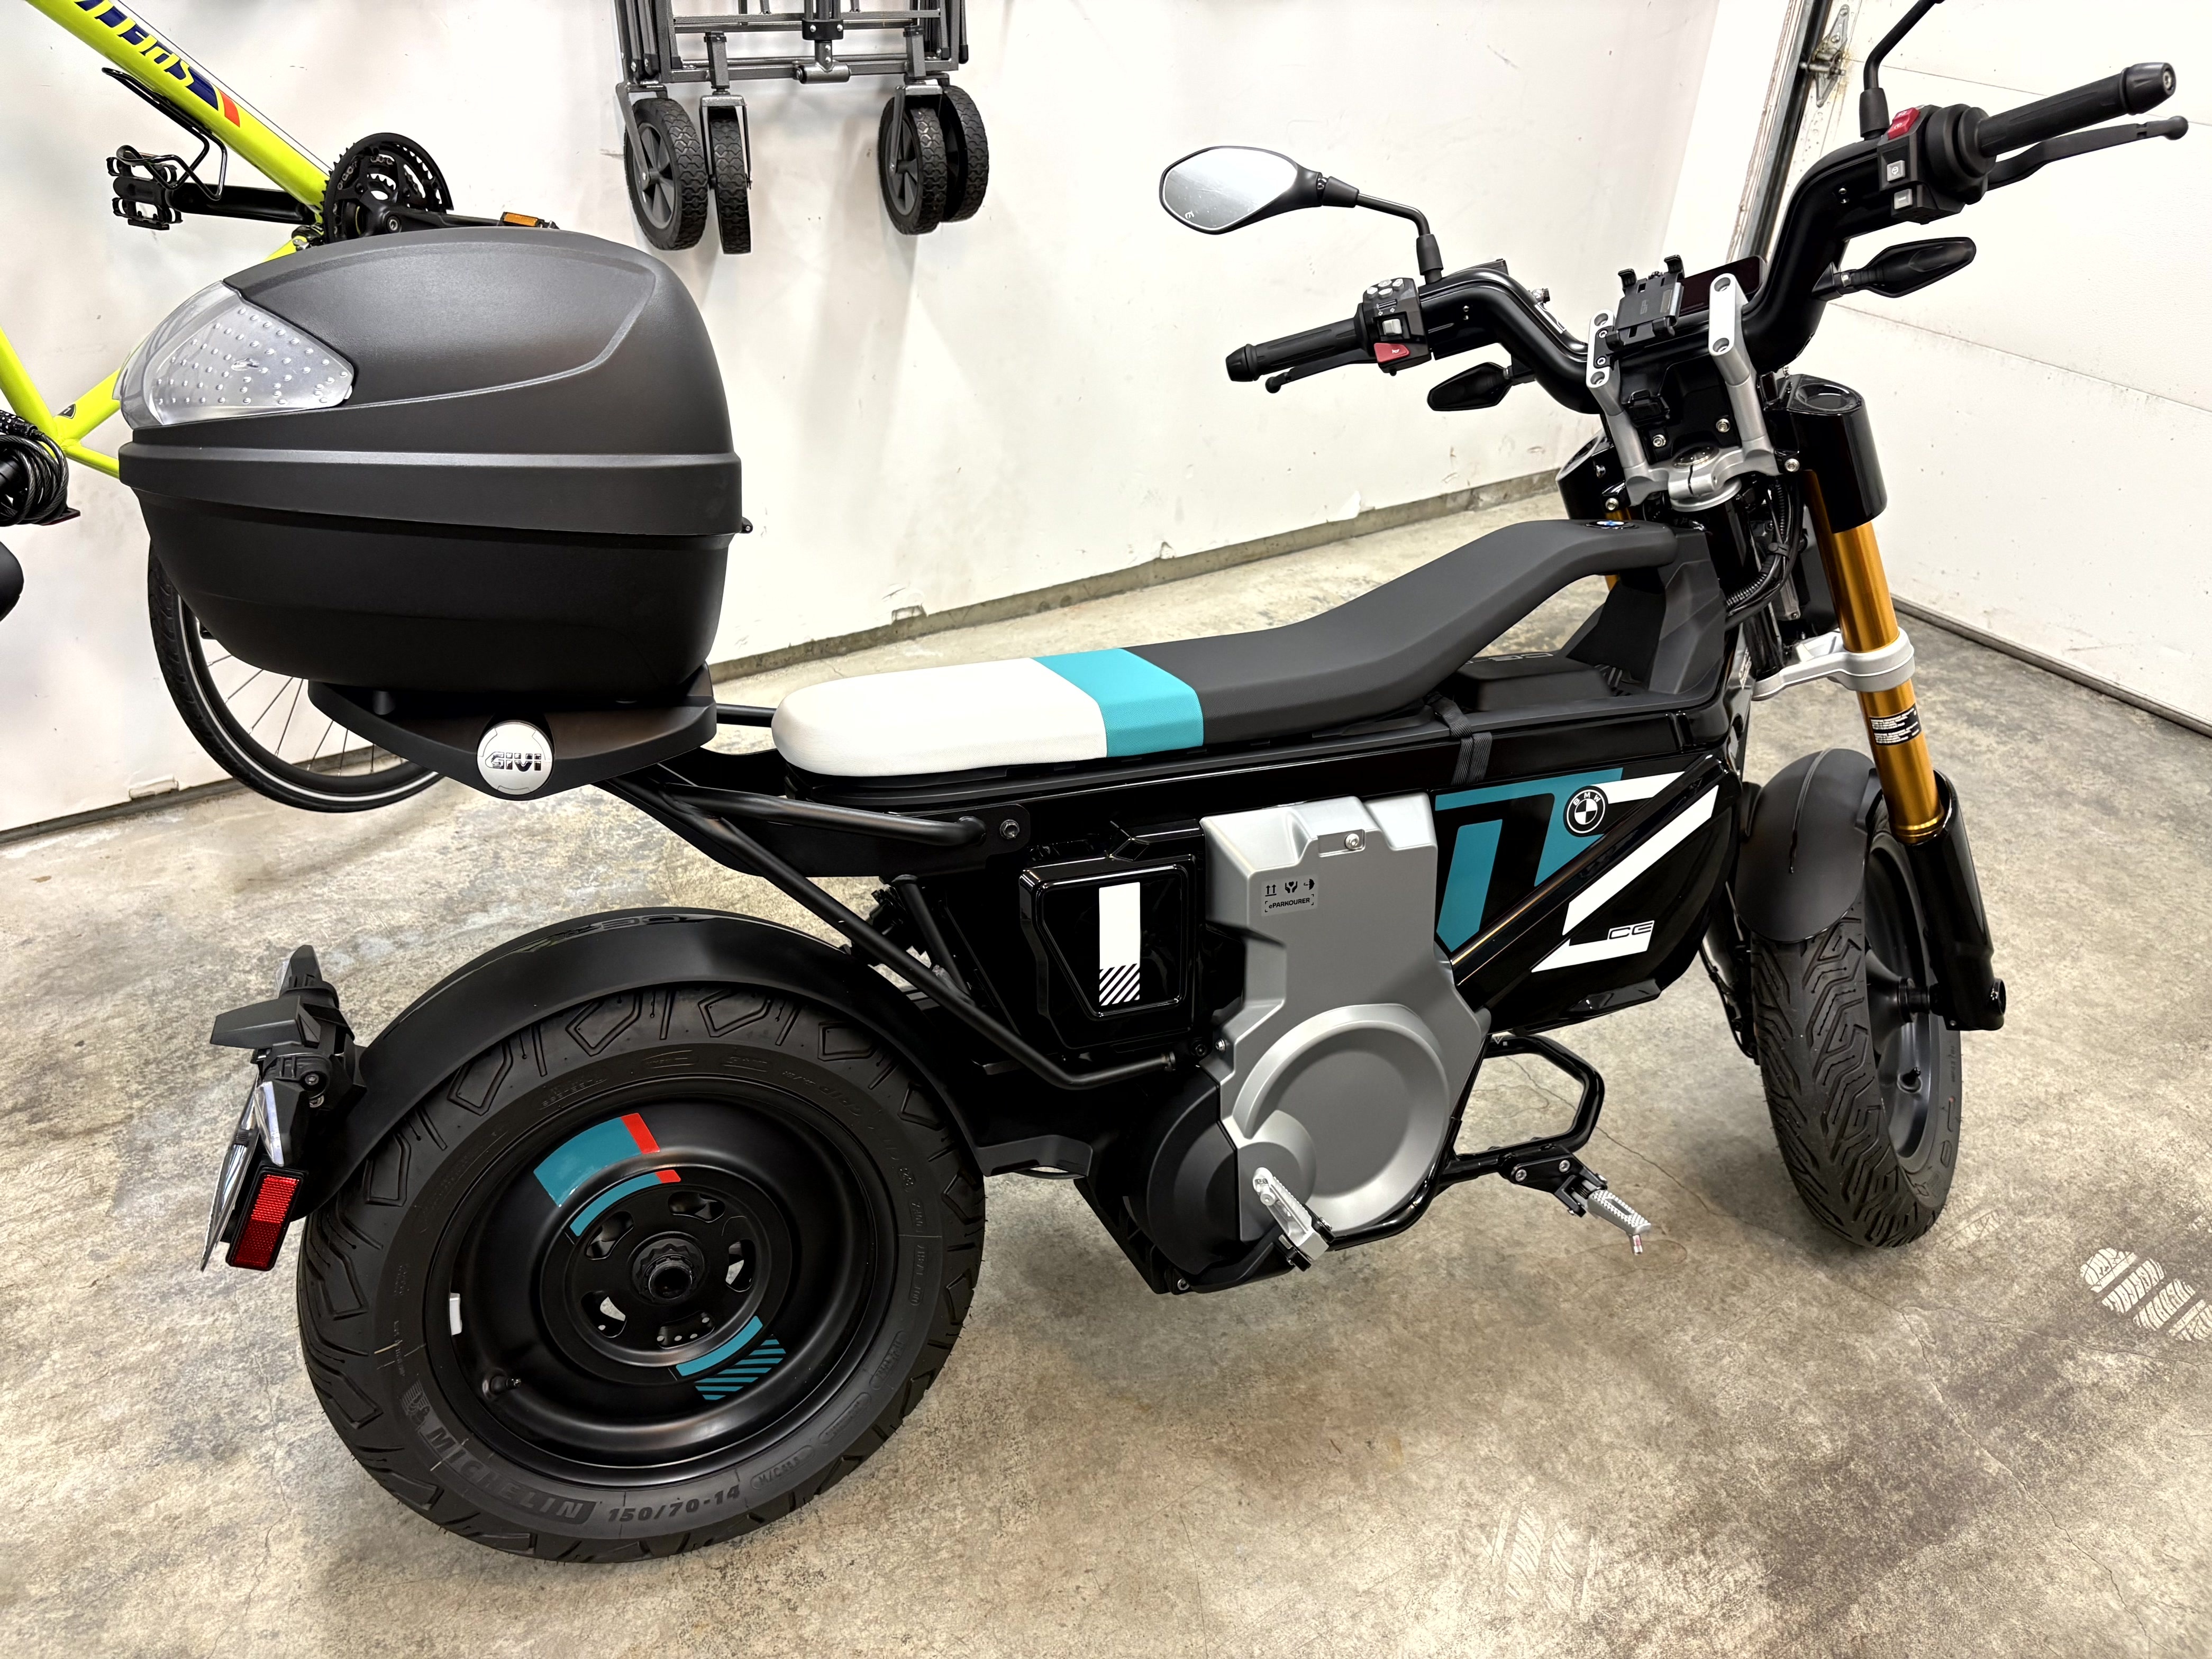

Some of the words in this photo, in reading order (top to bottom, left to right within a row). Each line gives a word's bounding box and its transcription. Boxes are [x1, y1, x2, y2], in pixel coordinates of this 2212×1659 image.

[75, 0, 195, 87] SPECI
[485, 751, 542, 772] GIVI
[1573, 792, 1601, 806] BMW
[1269, 898, 1310, 909] ePARKOURER
[426, 1427, 584, 1519] MICHELIN
[608, 1484, 740, 1522] 150/70-14
